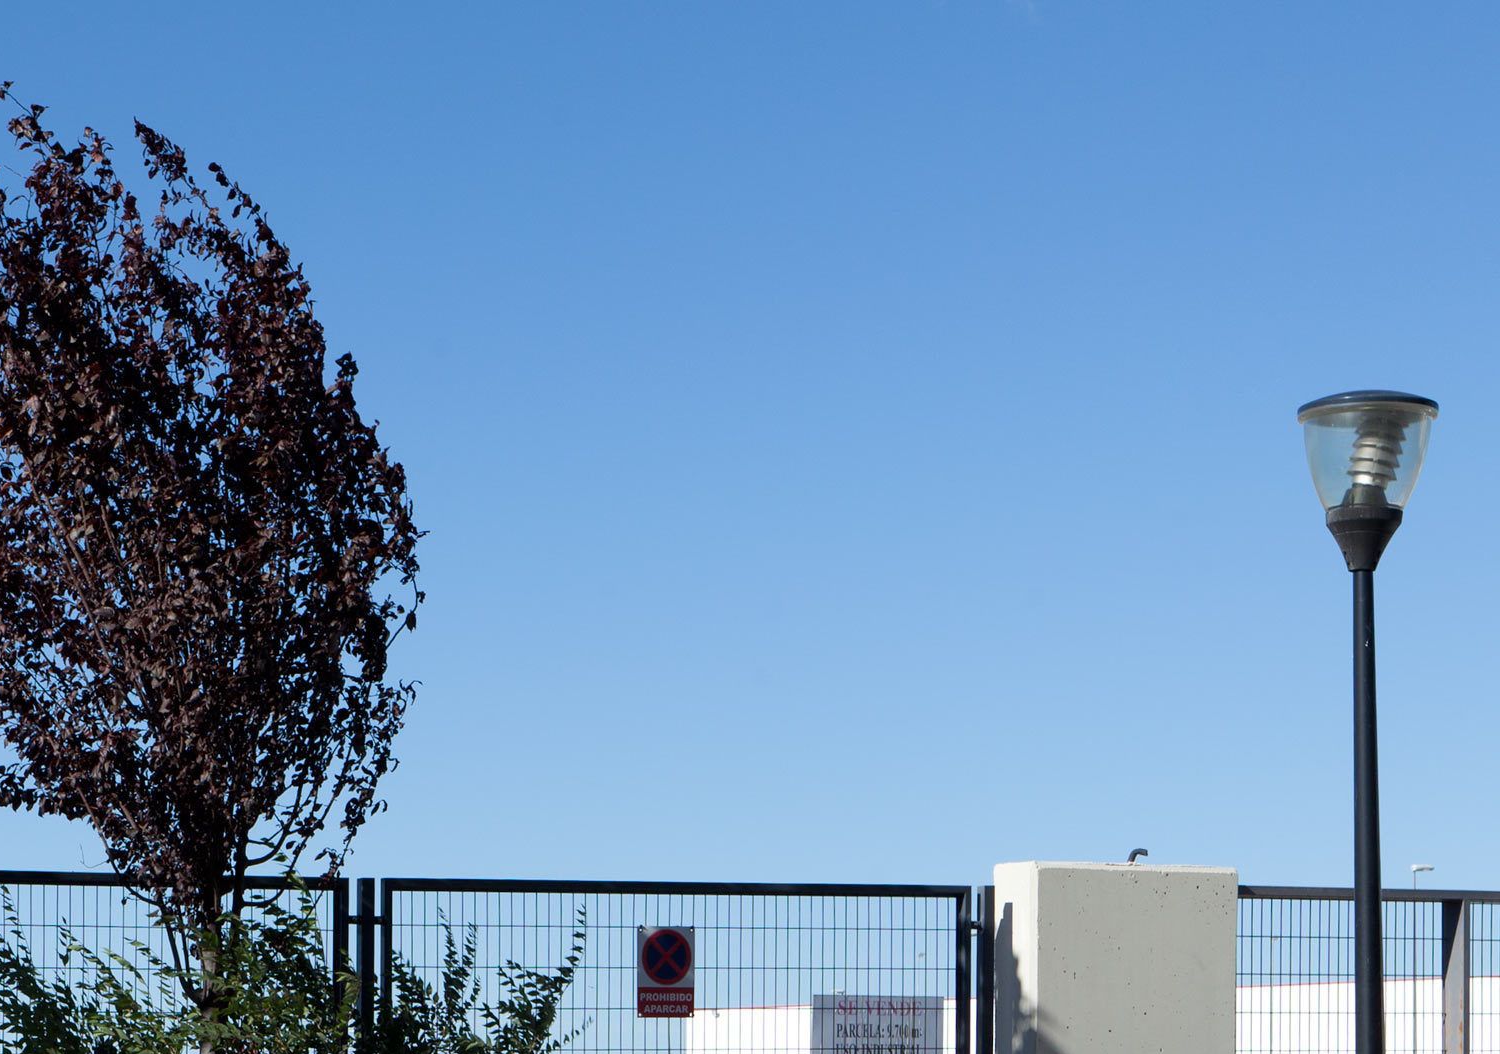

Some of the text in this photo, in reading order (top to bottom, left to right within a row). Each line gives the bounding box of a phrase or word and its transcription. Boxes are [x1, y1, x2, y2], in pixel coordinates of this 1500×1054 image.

[640, 992, 693, 1002] PROHIBIDO
[644, 1004, 689, 1014] APARCAR
[837, 999, 923, 1017] SE VENDE
[836, 1023, 885, 1039] PARCELA:
